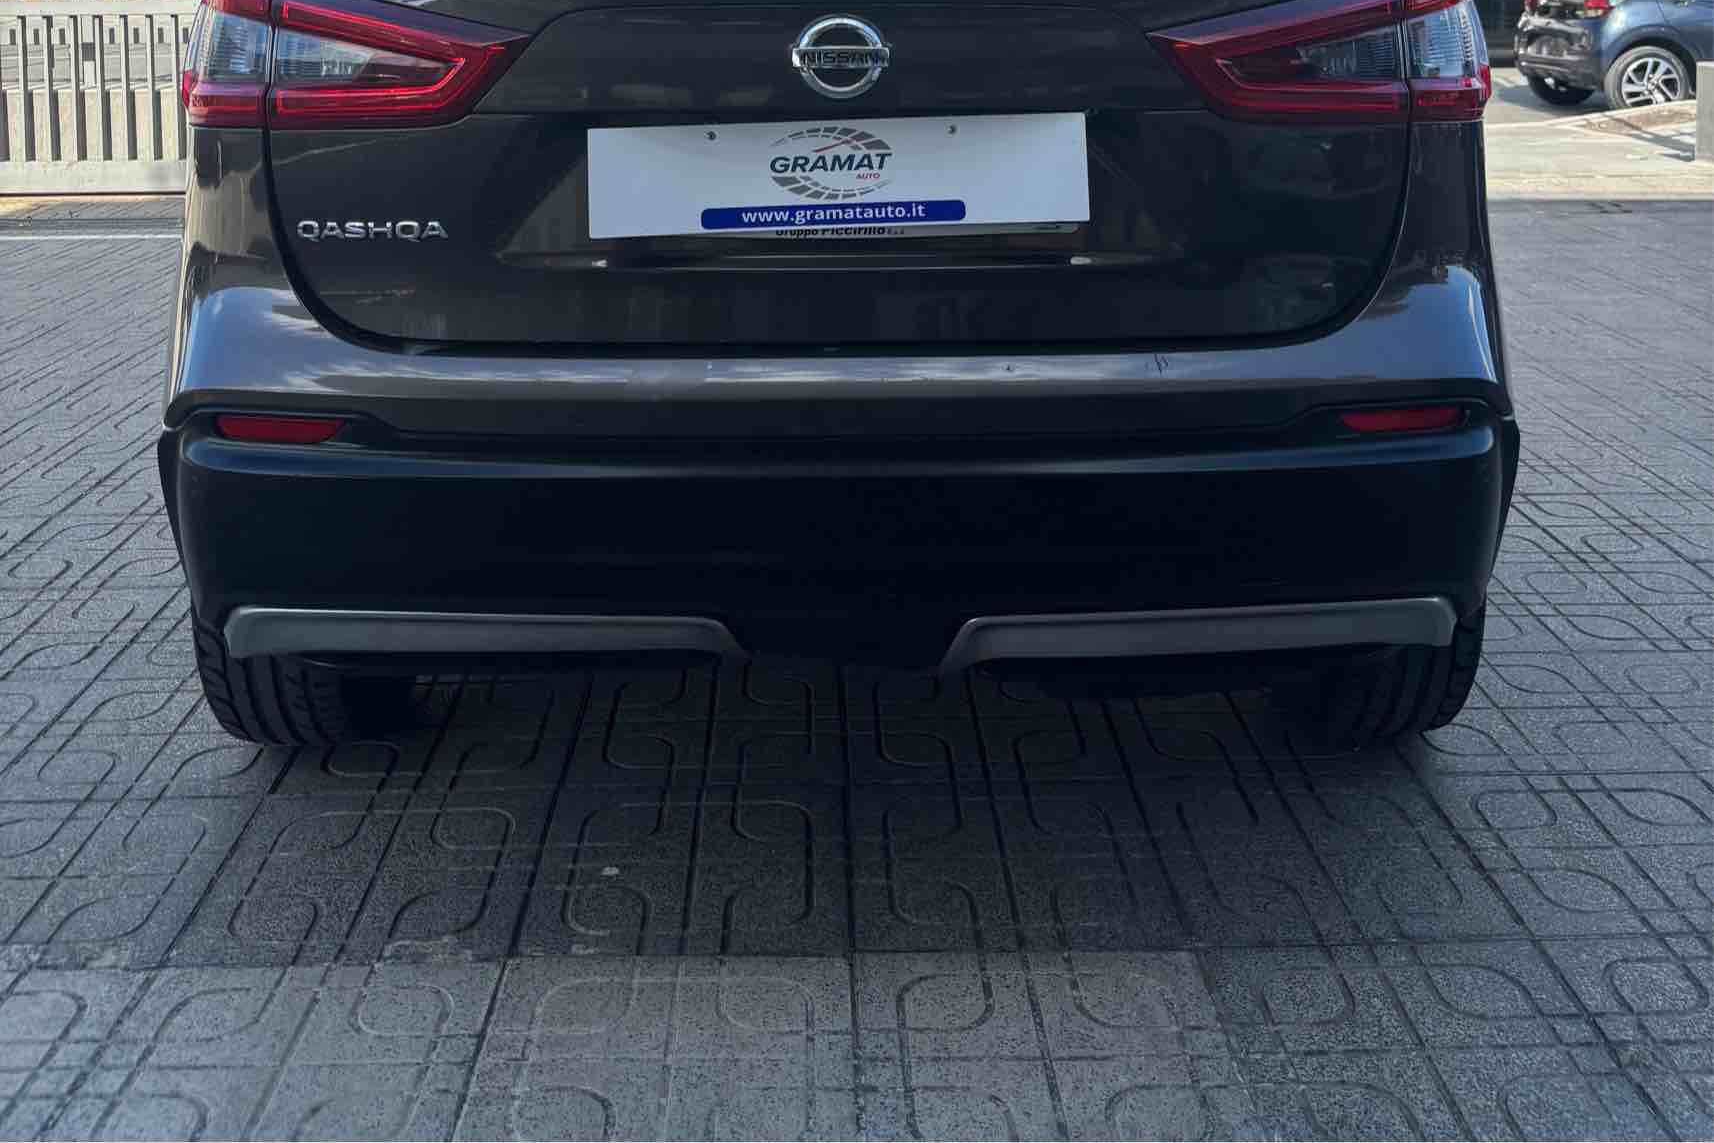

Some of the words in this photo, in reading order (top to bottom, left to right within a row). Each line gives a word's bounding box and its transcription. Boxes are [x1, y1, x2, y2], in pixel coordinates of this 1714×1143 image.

[799, 48, 884, 67] NISSAN
[769, 152, 893, 174] GRAMAT
[855, 172, 881, 180] AUTO
[741, 202, 926, 225] www.gramatauto.it
[297, 220, 449, 242] QASHQA
